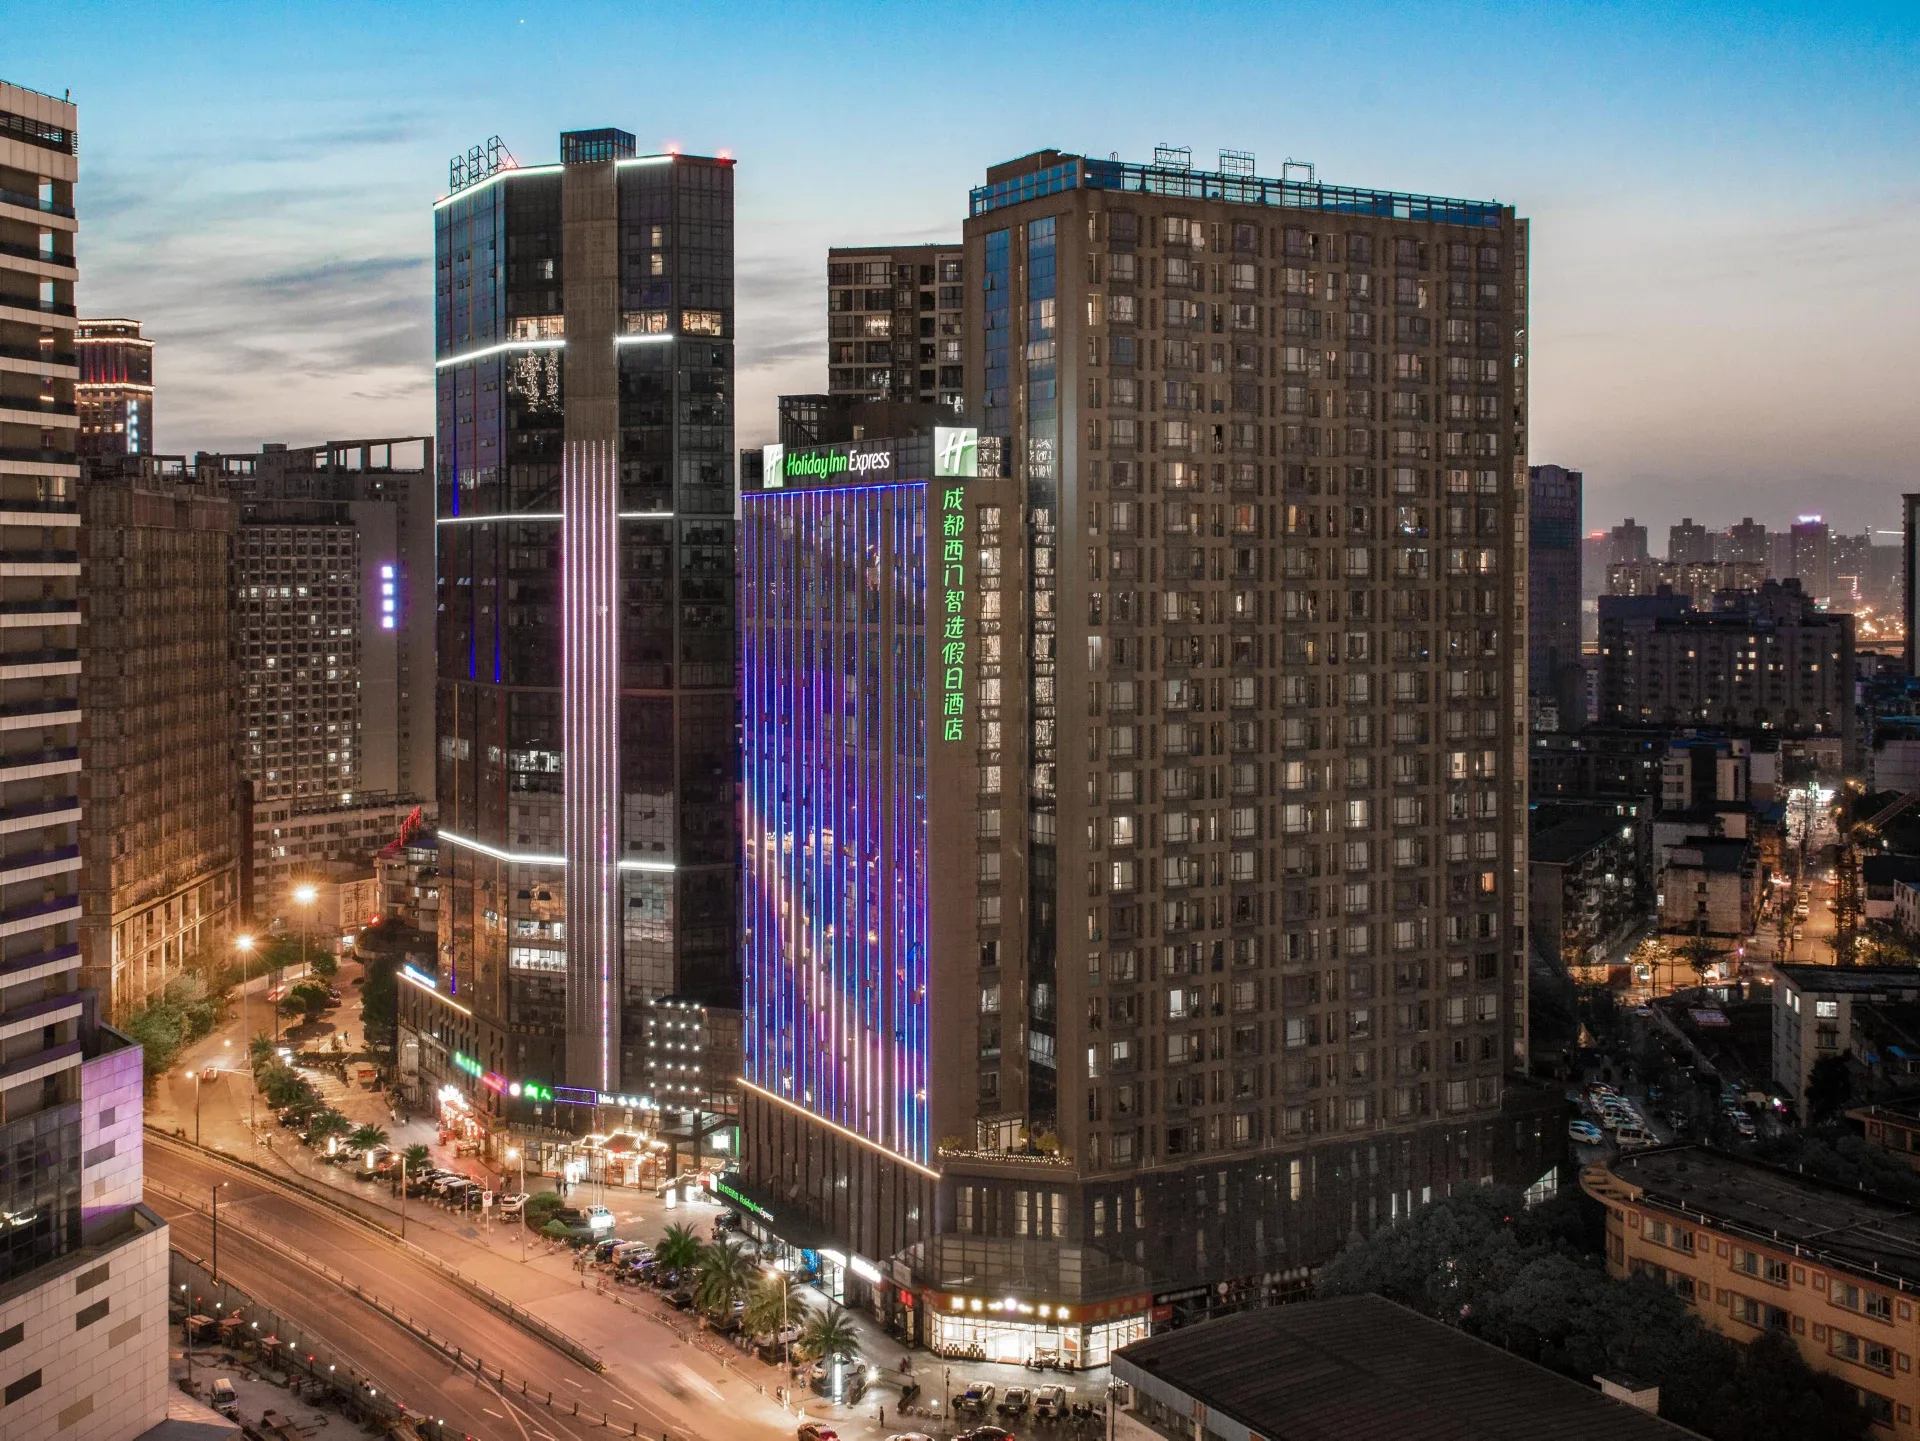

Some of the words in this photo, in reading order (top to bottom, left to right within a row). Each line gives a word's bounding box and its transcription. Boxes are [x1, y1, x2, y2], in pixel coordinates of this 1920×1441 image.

[849, 450, 890, 476] Express
[941, 487, 965, 741] 成都西门智选假日酒店
